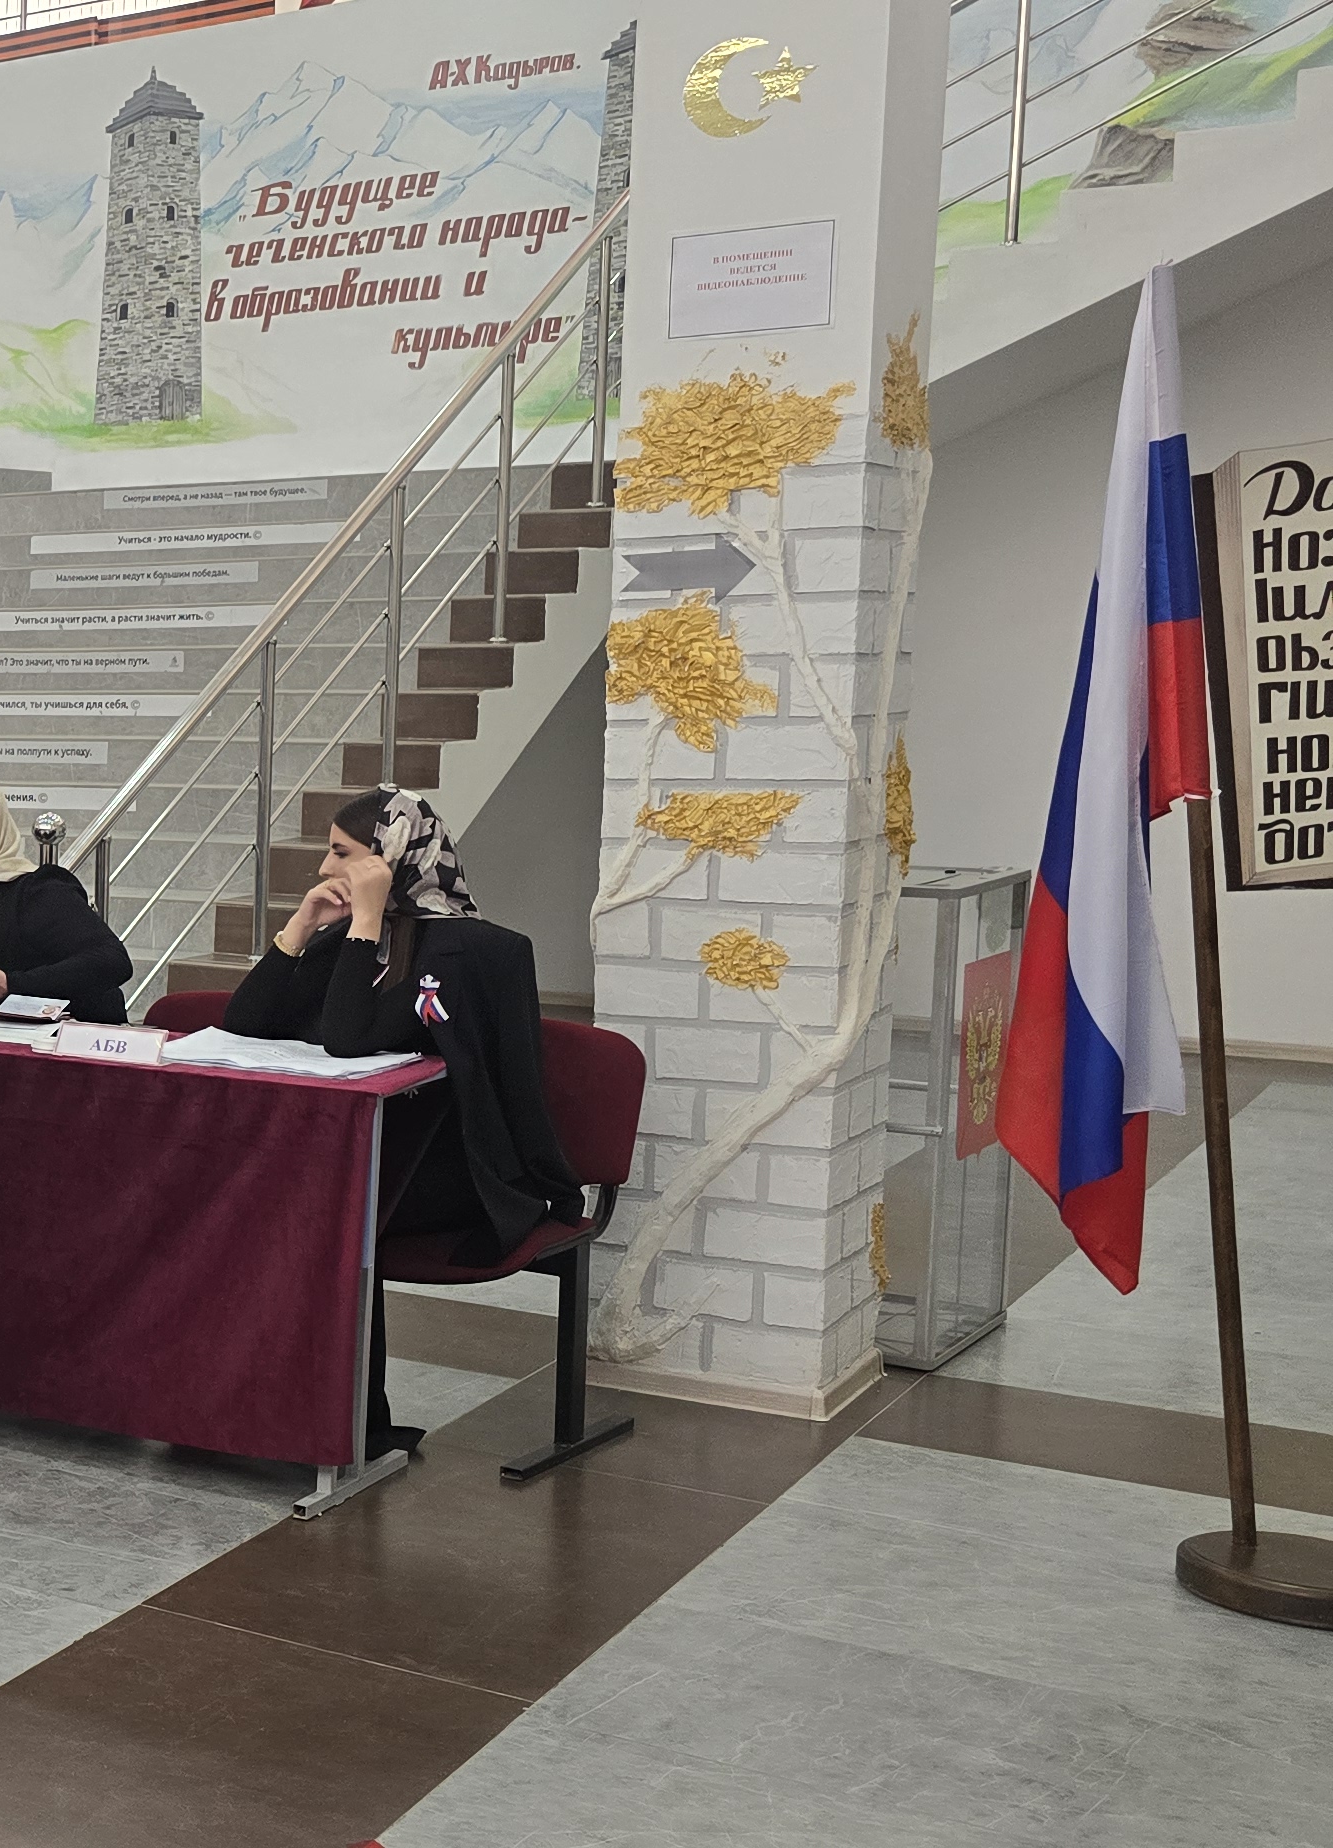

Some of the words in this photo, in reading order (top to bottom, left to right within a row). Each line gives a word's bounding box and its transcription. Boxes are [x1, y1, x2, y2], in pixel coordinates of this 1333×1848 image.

[474, 54, 581, 90] Кадыров.
[225, 223, 428, 268] чеченского
[721, 249, 793, 263] ПОМЕЩЕНИИ
[697, 274, 807, 290] ВИДЕОНАБЛЮДЕНИЕ
[230, 267, 441, 332] образовании
[463, 270, 487, 297] и
[123, 495, 151, 504] Смотри
[201, 492, 223, 500] назад
[269, 487, 307, 497] будущее.
[118, 536, 151, 544] Учиться
[174, 534, 205, 542] начало
[207, 532, 251, 542] мудрости.
[56, 574, 99, 582] Маленькие
[123, 572, 145, 582] ведут
[153, 570, 190, 580] большим
[192, 568, 229, 578] победам.
[15, 616, 49, 625] Учиться
[51, 616, 80, 624] значит
[82, 616, 108, 626] расти,
[118, 614, 143, 625] расти
[145, 614, 176, 622] значит
[178, 613, 203, 621] жить.
[10, 658, 23, 666] Это
[25, 659, 54, 667] значит,
[95, 658, 126, 667] верном
[128, 658, 150, 667] пути.
[44, 701, 83, 710] учишься
[86, 701, 103, 710] для
[105, 699, 128, 709] себя.
[5, 748, 15, 756] на
[17, 749, 51, 759] полпути
[61, 750, 92, 759] успеху.
[5, 794, 36, 802] чения.
[89, 1038, 127, 1054] АБВ
